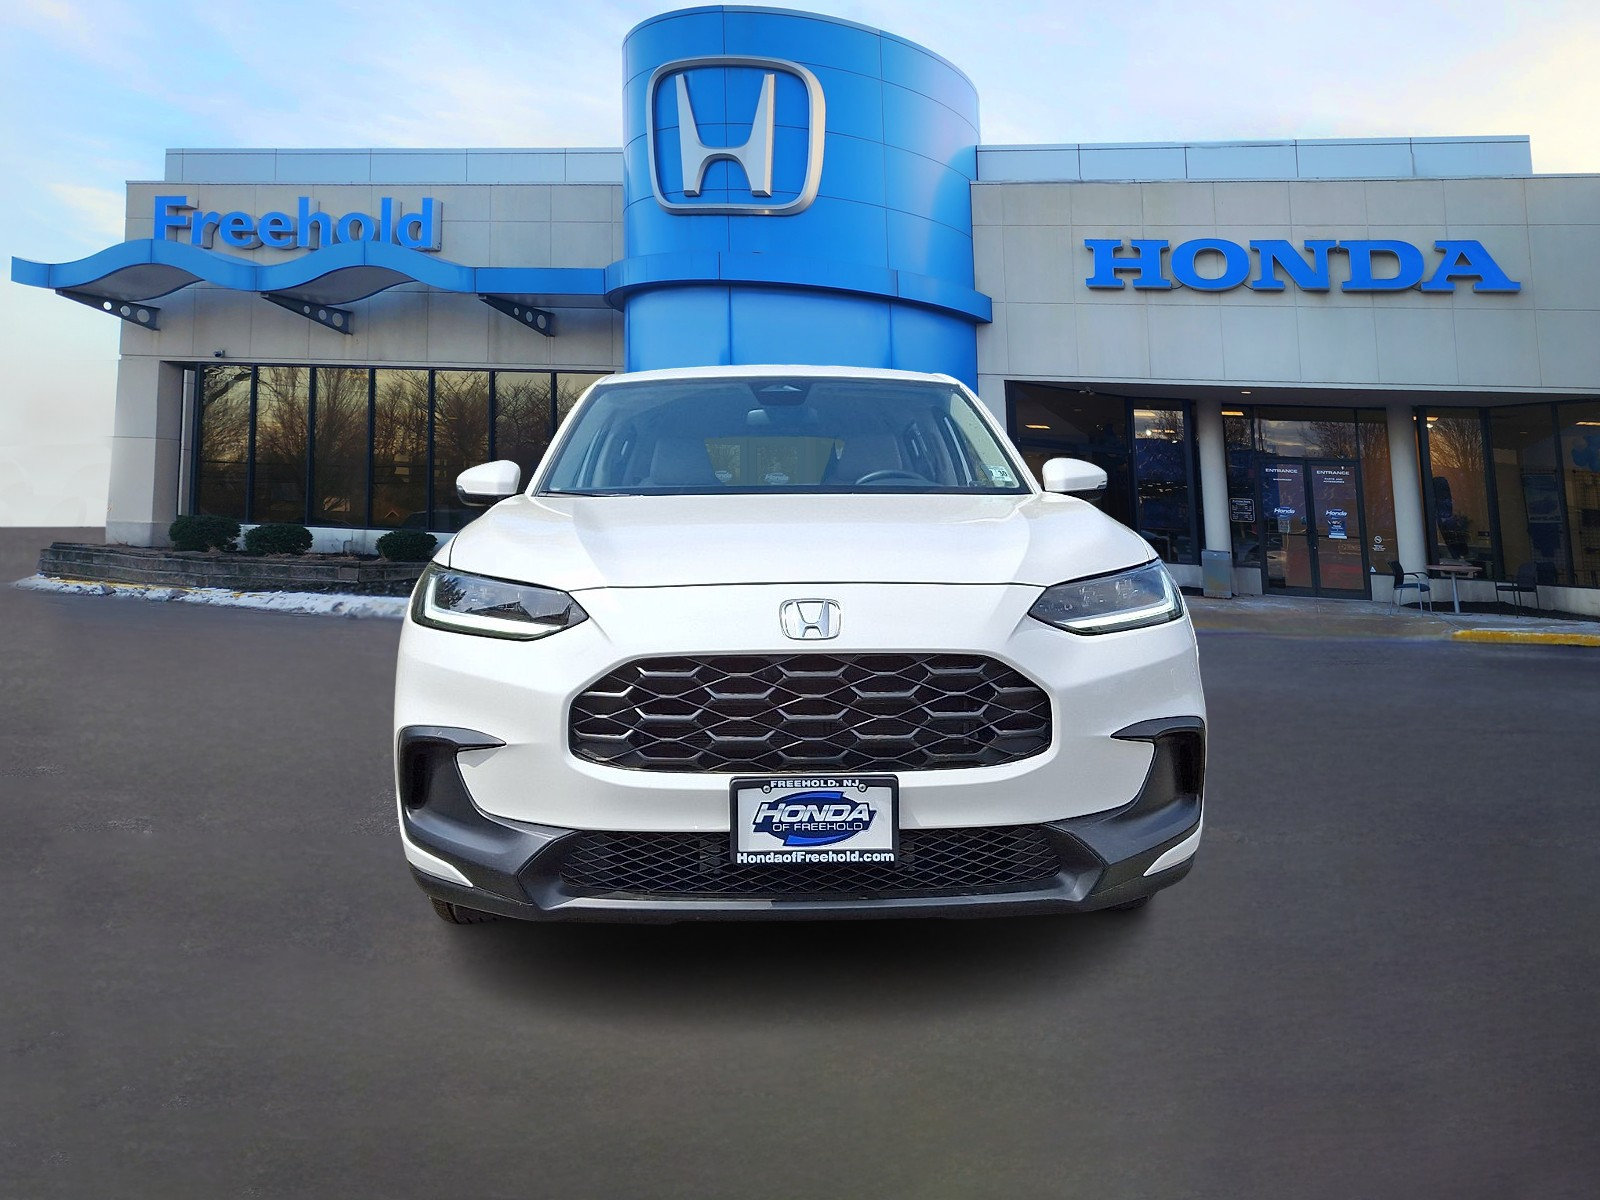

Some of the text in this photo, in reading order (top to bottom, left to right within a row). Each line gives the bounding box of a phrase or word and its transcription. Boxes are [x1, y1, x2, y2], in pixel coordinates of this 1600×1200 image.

[153, 195, 434, 249] Freehold
[1084, 238, 1522, 293] HONDA
[770, 780, 840, 788] FREEHOLD,
[755, 804, 870, 822] HONDA
[772, 822, 863, 831] OF FREEHOLD
[736, 851, 895, 864] HondaofFreehold.com
